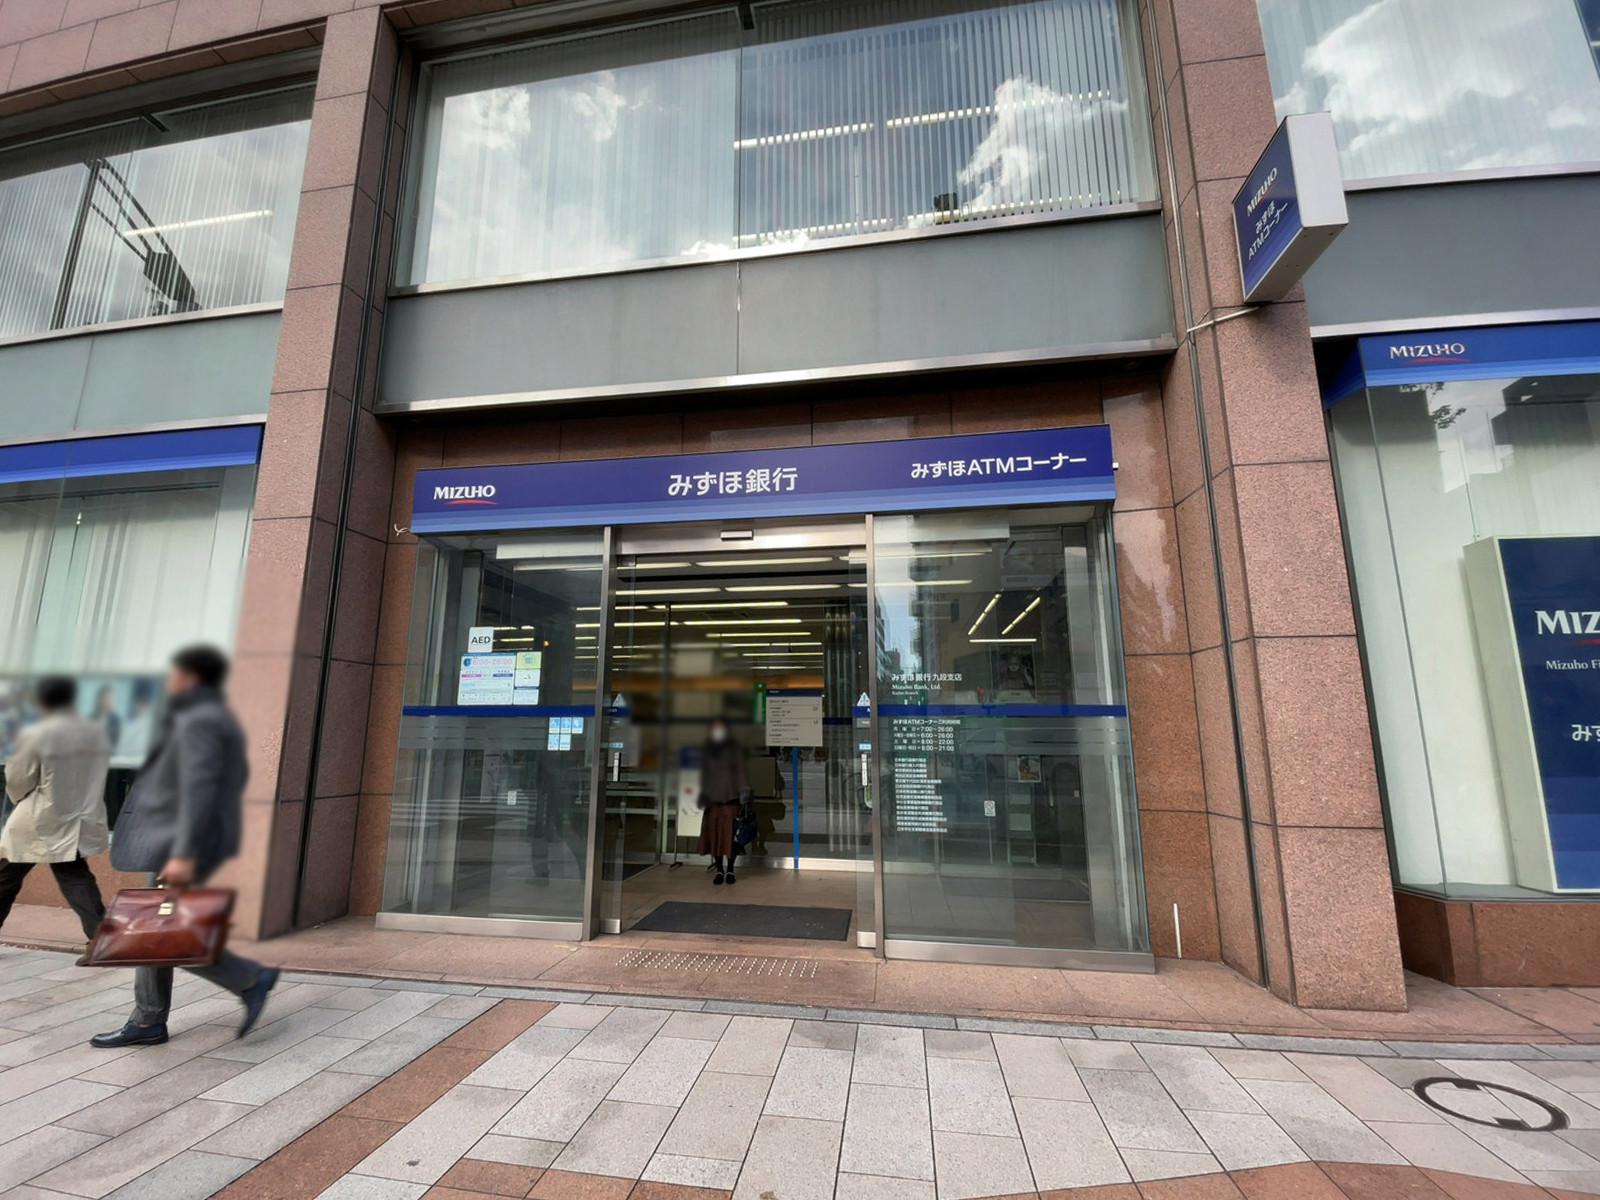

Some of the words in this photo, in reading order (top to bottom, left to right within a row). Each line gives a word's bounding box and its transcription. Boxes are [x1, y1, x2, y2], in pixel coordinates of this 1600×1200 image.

[1247, 167, 1278, 217] MIZUHO
[1255, 200, 1276, 234] みずほ
[1248, 202, 1289, 261] ATMコーナー
[1389, 342, 1466, 359] MIZUHO
[910, 452, 1087, 479] みずほATMコーナー
[433, 484, 496, 500] MIZUHO
[668, 467, 798, 497] みずほ銀行
[471, 636, 491, 644] AED
[1545, 659, 1589, 670] Mizuho
